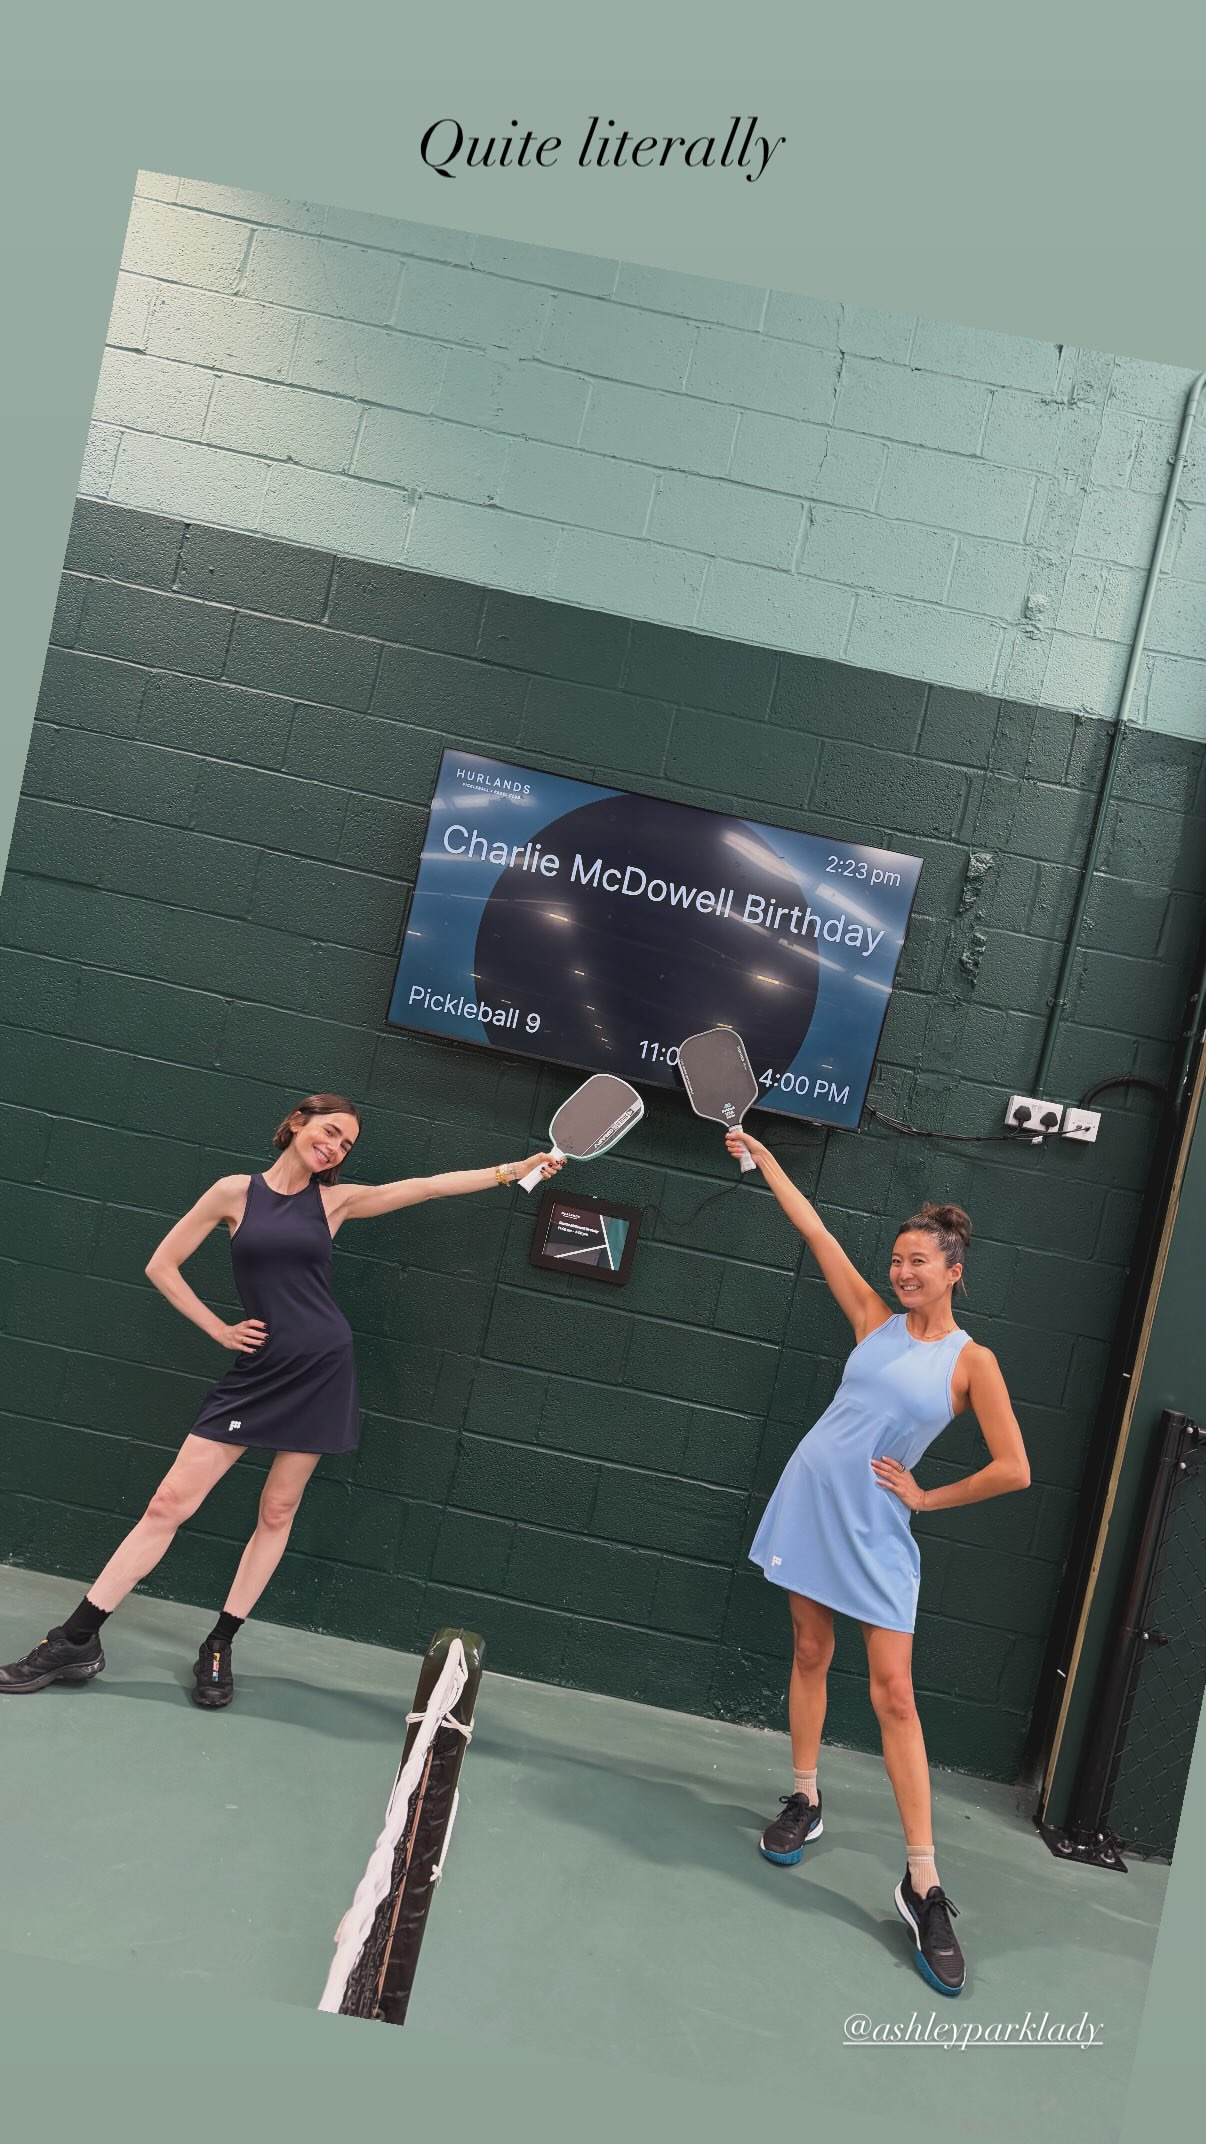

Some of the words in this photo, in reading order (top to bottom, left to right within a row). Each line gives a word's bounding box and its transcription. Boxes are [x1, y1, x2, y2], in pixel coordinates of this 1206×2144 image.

[456, 768, 531, 794] HURLANDS
[443, 824, 560, 877] Charlie
[570, 853, 734, 918] McDowell
[743, 894, 886, 957] Birthday
[825, 855, 868, 879] 2:23
[870, 868, 901, 887] pm
[408, 985, 520, 1029] Pickleball
[525, 1013, 541, 1033] 9
[639, 1040, 680, 1066] 11:0
[758, 1068, 810, 1095] 4:00
[813, 1080, 850, 1105] PM
